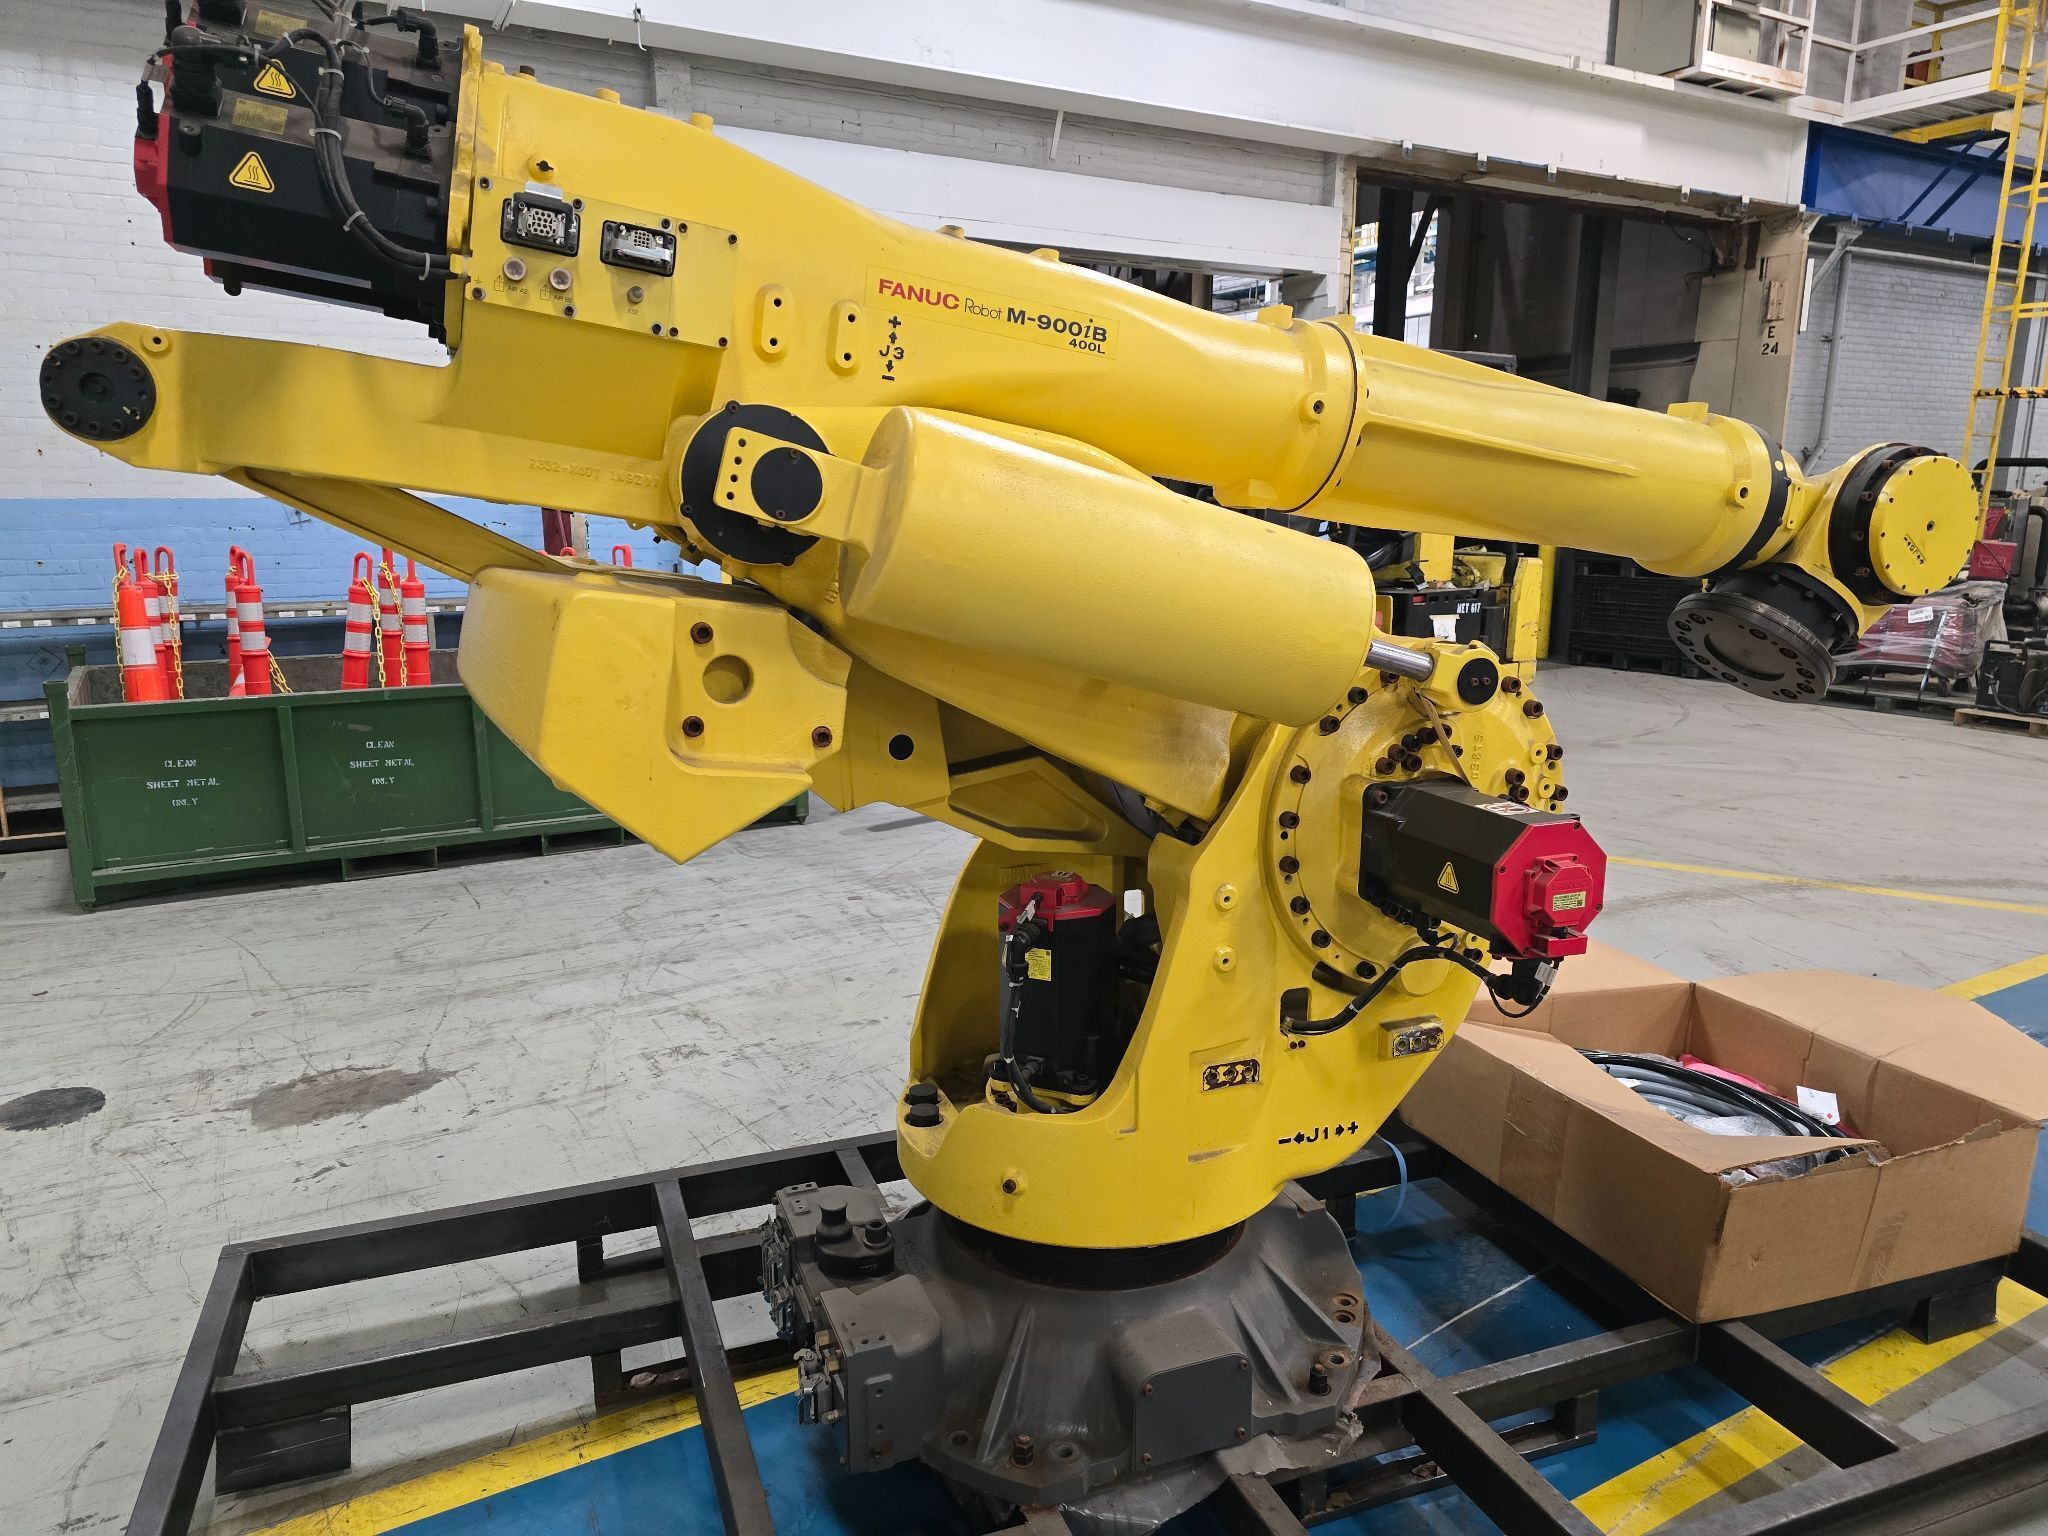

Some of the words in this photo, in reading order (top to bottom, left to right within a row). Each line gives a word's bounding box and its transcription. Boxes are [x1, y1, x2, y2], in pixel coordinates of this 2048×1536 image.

[878, 278, 960, 310] FANUC
[964, 297, 1002, 320] Robot
[1006, 307, 1107, 343] M-900iB
[1767, 325, 1776, 339] E
[878, 344, 905, 360] J3
[1068, 338, 1106, 355] 400L
[1761, 341, 1779, 355] 24
[1457, 602, 1470, 613] MET
[365, 740, 395, 749] CLEAN
[163, 759, 197, 768] CLEAN
[349, 759, 380, 769] SHEET
[384, 758, 415, 768] METAL
[146, 779, 180, 790] SHEET
[186, 777, 220, 788] METAL
[371, 776, 396, 786] ONLY
[171, 797, 199, 807] ONLY
[1306, 1127, 1328, 1143] J1
